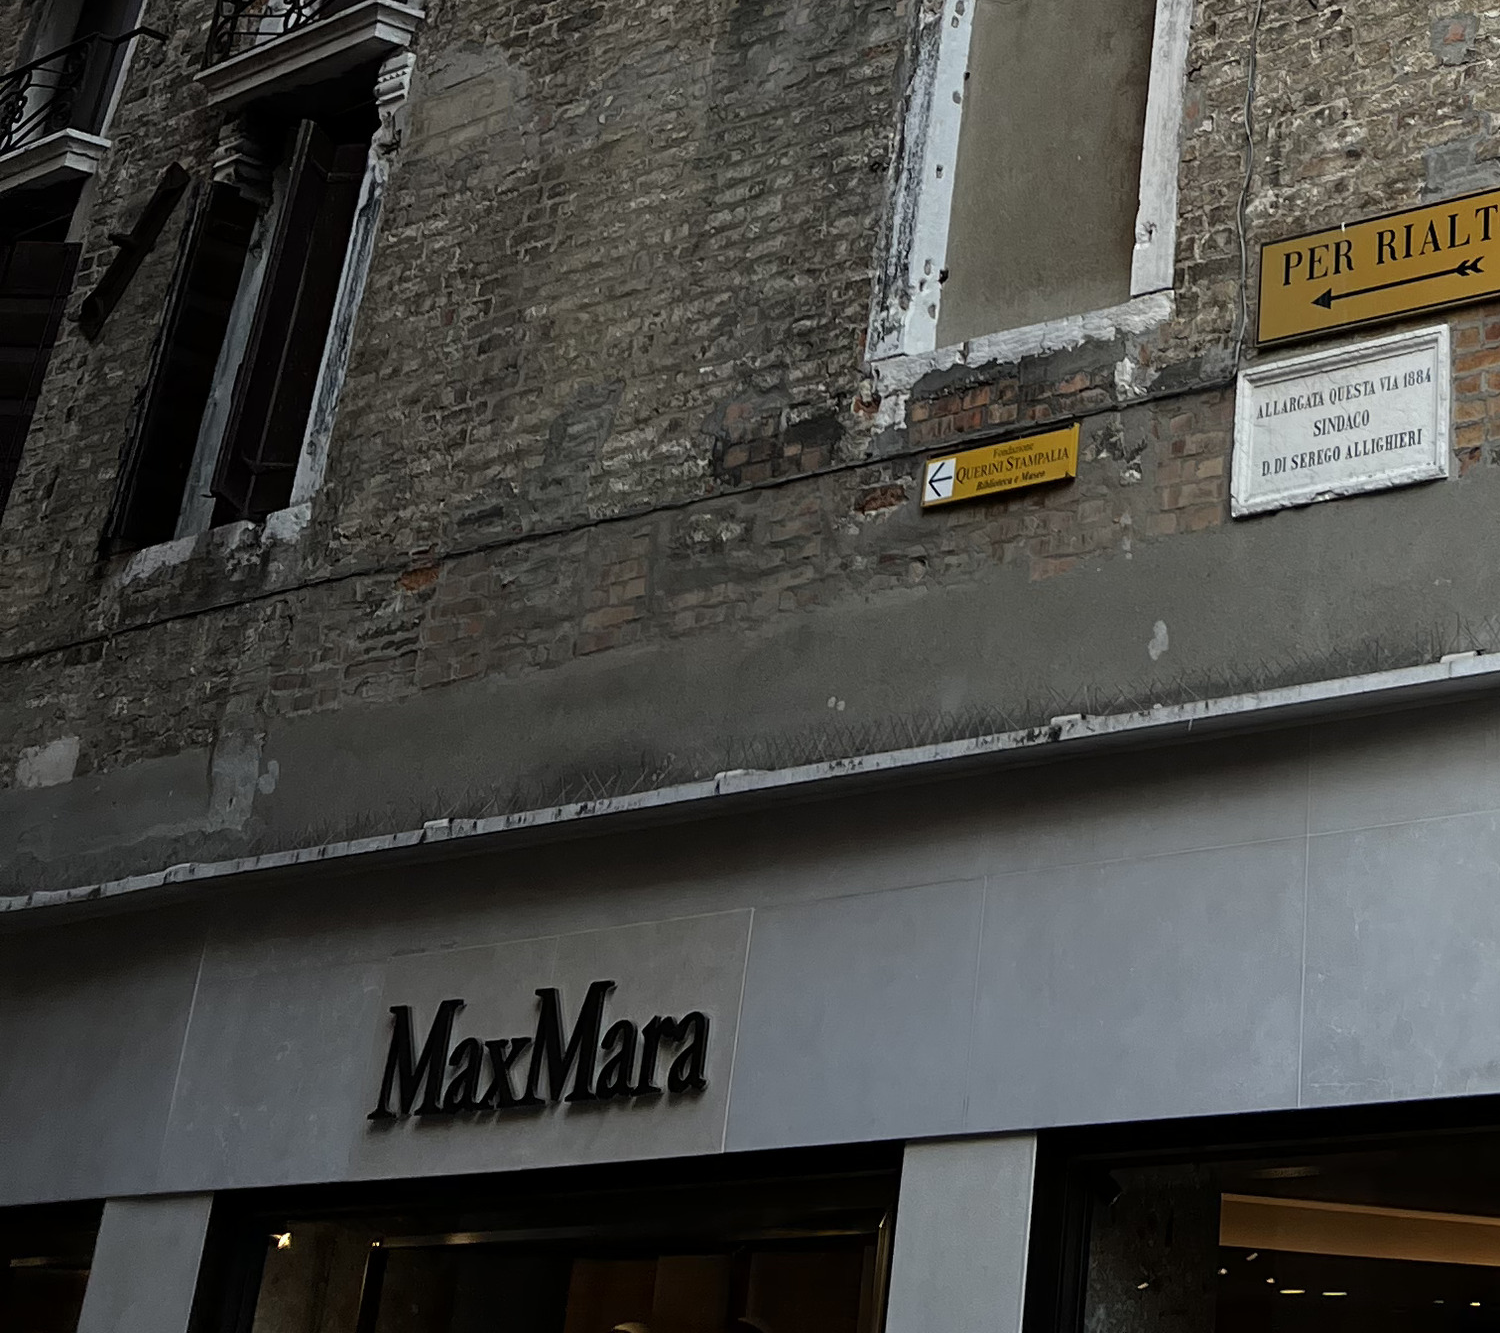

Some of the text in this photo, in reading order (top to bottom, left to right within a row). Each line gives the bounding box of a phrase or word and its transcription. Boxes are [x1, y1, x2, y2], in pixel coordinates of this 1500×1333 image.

[1282, 239, 1355, 286] PER
[1256, 367, 1432, 420] ALLARGATA QUESTA VIA 1884
[1312, 409, 1371, 437] SINDACO
[956, 447, 1069, 484] QUERINI STAMPALIA
[1290, 445, 1341, 471] SEREGO
[1344, 428, 1423, 460] ALLIGHIERI
[367, 980, 711, 1120] MaxMara
